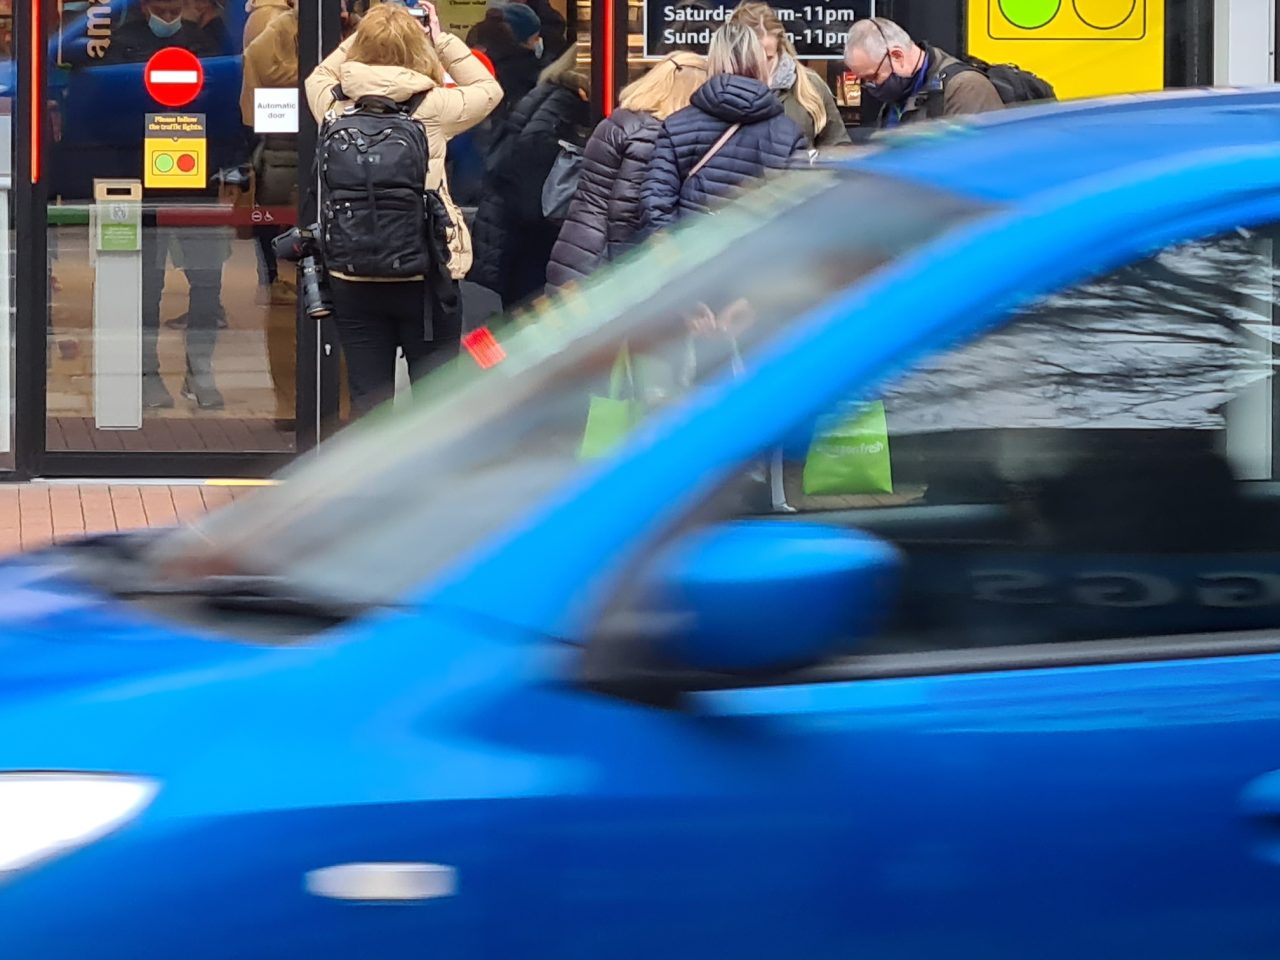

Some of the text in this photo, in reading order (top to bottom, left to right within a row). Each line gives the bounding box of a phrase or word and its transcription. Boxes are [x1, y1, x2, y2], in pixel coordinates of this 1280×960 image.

[664, 6, 855, 24] Saturda m-11pm
[664, 29, 714, 45] Sund
